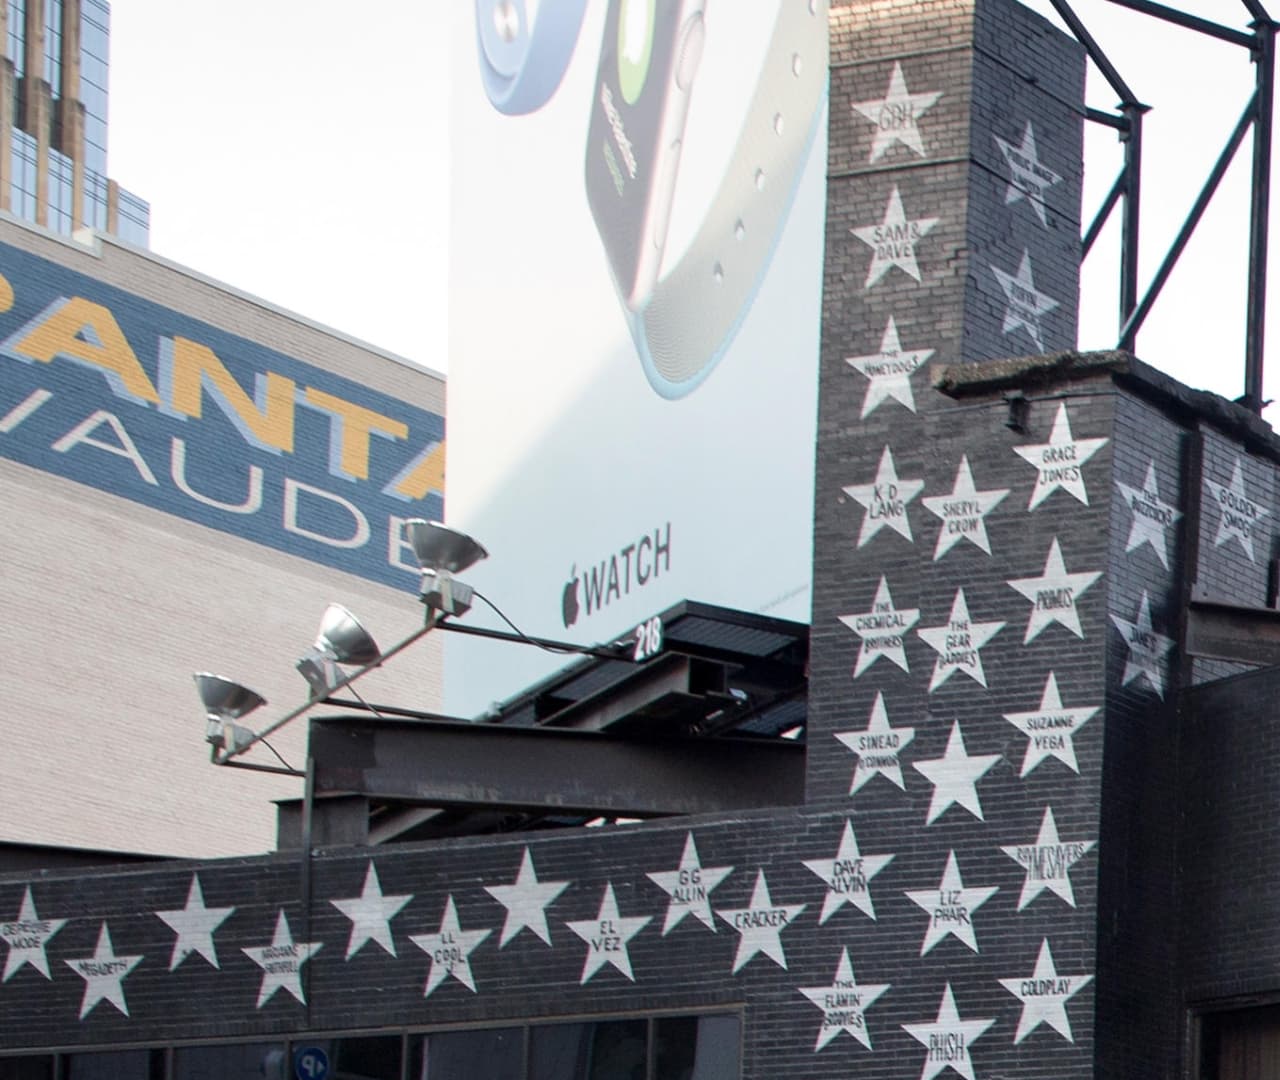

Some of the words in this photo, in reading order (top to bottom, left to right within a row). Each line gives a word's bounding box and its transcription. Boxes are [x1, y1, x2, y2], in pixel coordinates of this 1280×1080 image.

[877, 243, 912, 260] DAVE
[0, 273, 446, 502] ANT
[1042, 446, 1077, 463] GRACE
[1039, 466, 1080, 485] JONES
[869, 503, 904, 519] LANG
[943, 502, 982, 517] SHERYL
[1219, 489, 1257, 520] GOLDEN
[949, 518, 979, 534] CROW
[584, 522, 671, 616] WATCH
[856, 613, 907, 631] CHEMICAL
[951, 620, 969, 631] THE
[634, 616, 661, 661] 218
[1026, 714, 1075, 731] SUZANNE
[859, 735, 900, 752] SINEAD
[1034, 735, 1066, 750] VEGA
[833, 859, 864, 875] DAVE
[829, 875, 866, 894] ALVIN
[673, 887, 706, 902] ALLIN
[940, 890, 961, 905] LIZ
[735, 909, 788, 928] CRACKER
[934, 907, 971, 927] PHAIR
[601, 920, 616, 935] EL
[12, 936, 41, 949] MODE
[441, 932, 455, 944] LL
[592, 937, 621, 952] VEZ
[434, 949, 465, 965] COOL
[1021, 978, 1071, 996] COLDPLAY
[930, 1033, 964, 1061] PHISH
